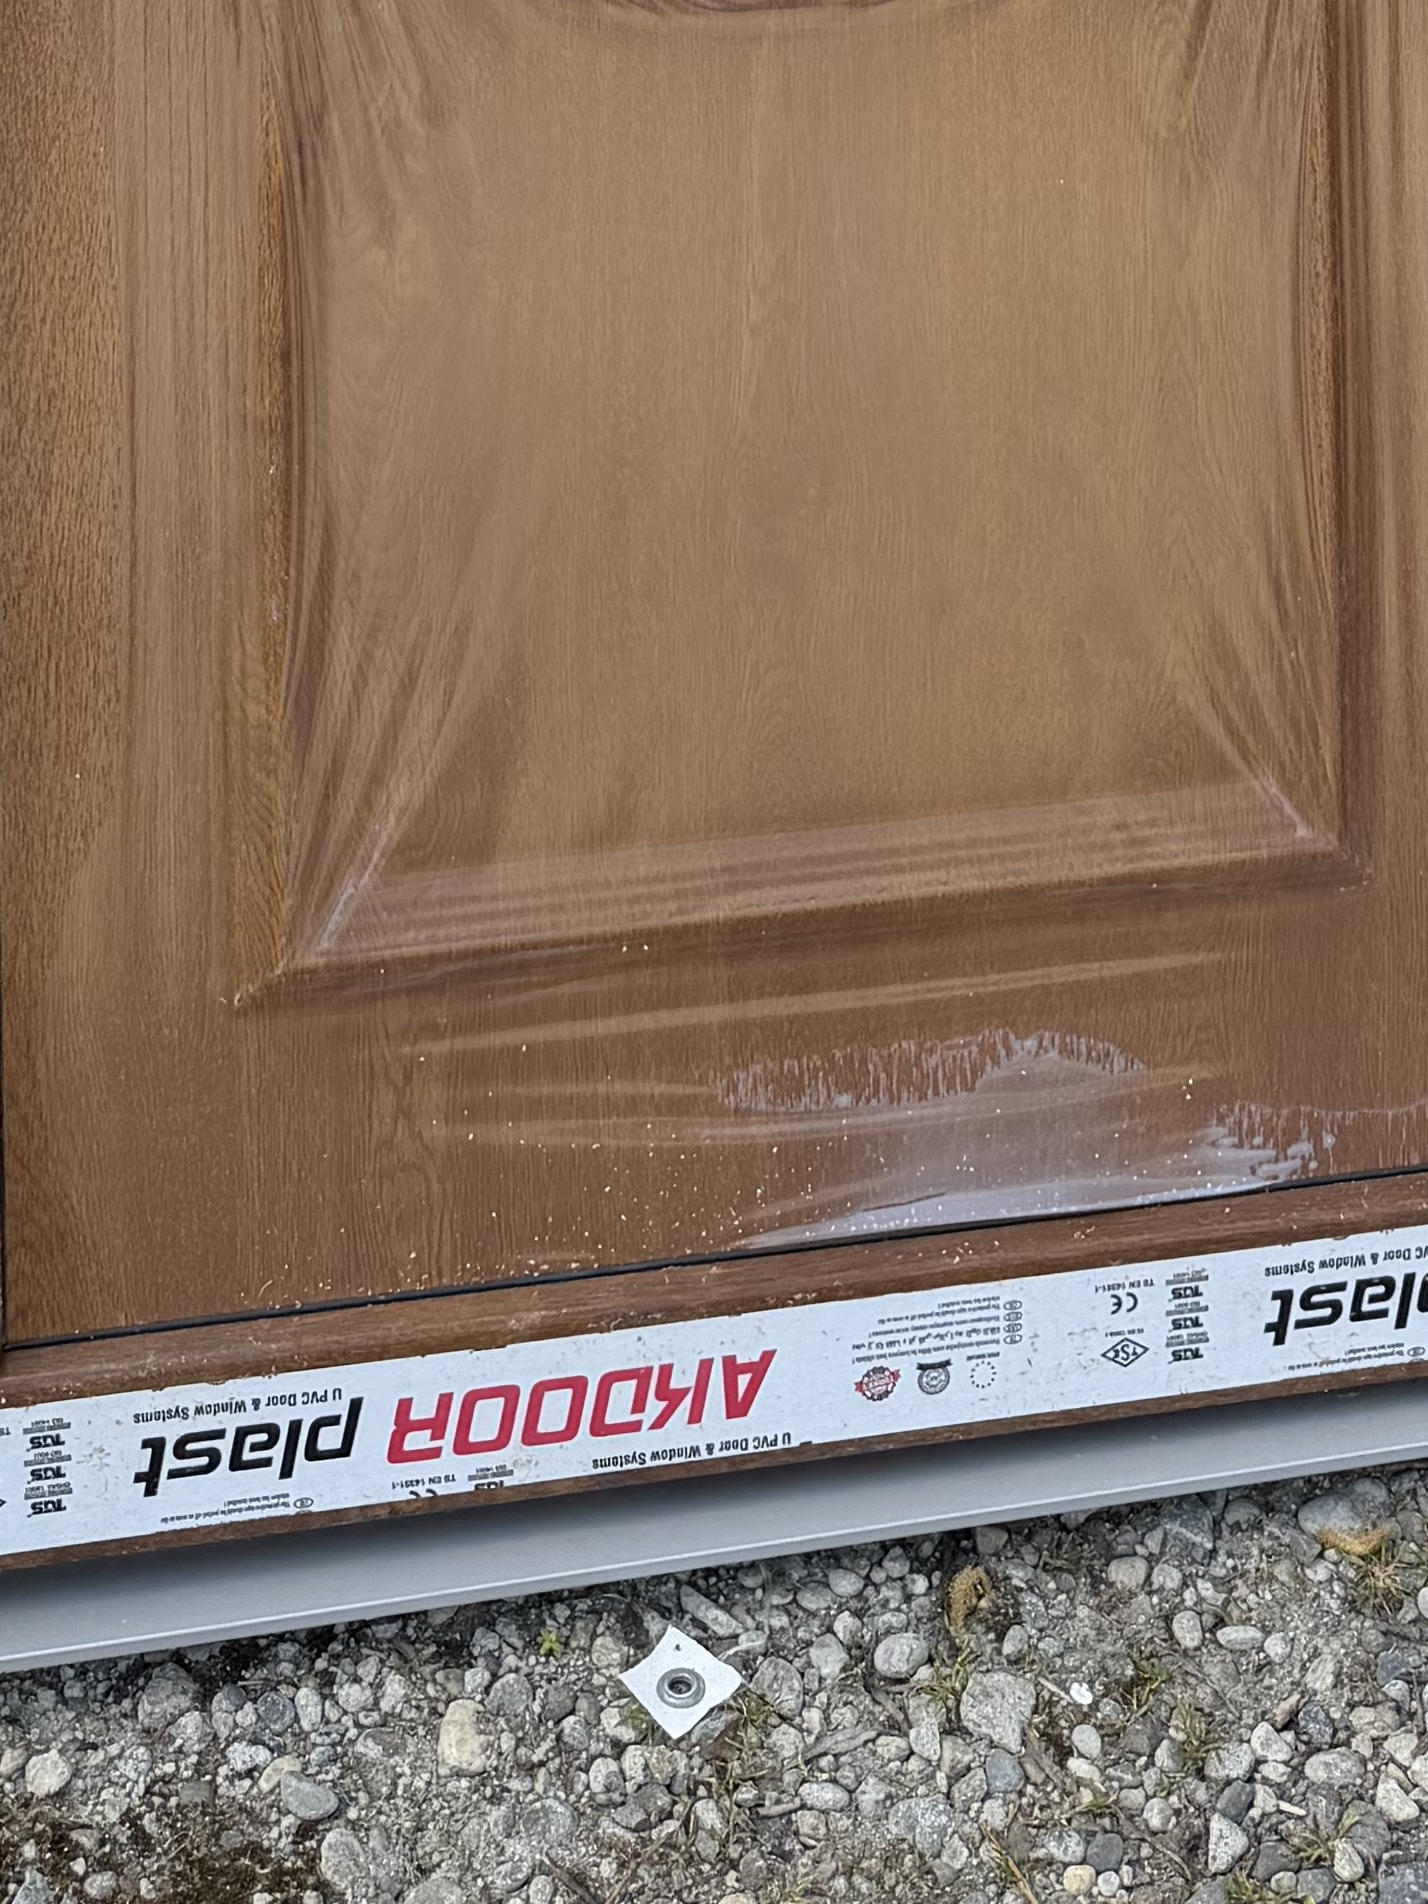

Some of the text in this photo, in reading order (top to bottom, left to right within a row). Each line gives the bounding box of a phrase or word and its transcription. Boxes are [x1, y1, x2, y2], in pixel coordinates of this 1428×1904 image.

[1107, 1295, 1138, 1315] CE
[132, 1387, 342, 1424] U PVC Door & Window Systems
[133, 1349, 776, 1498] AKDOOR plast
